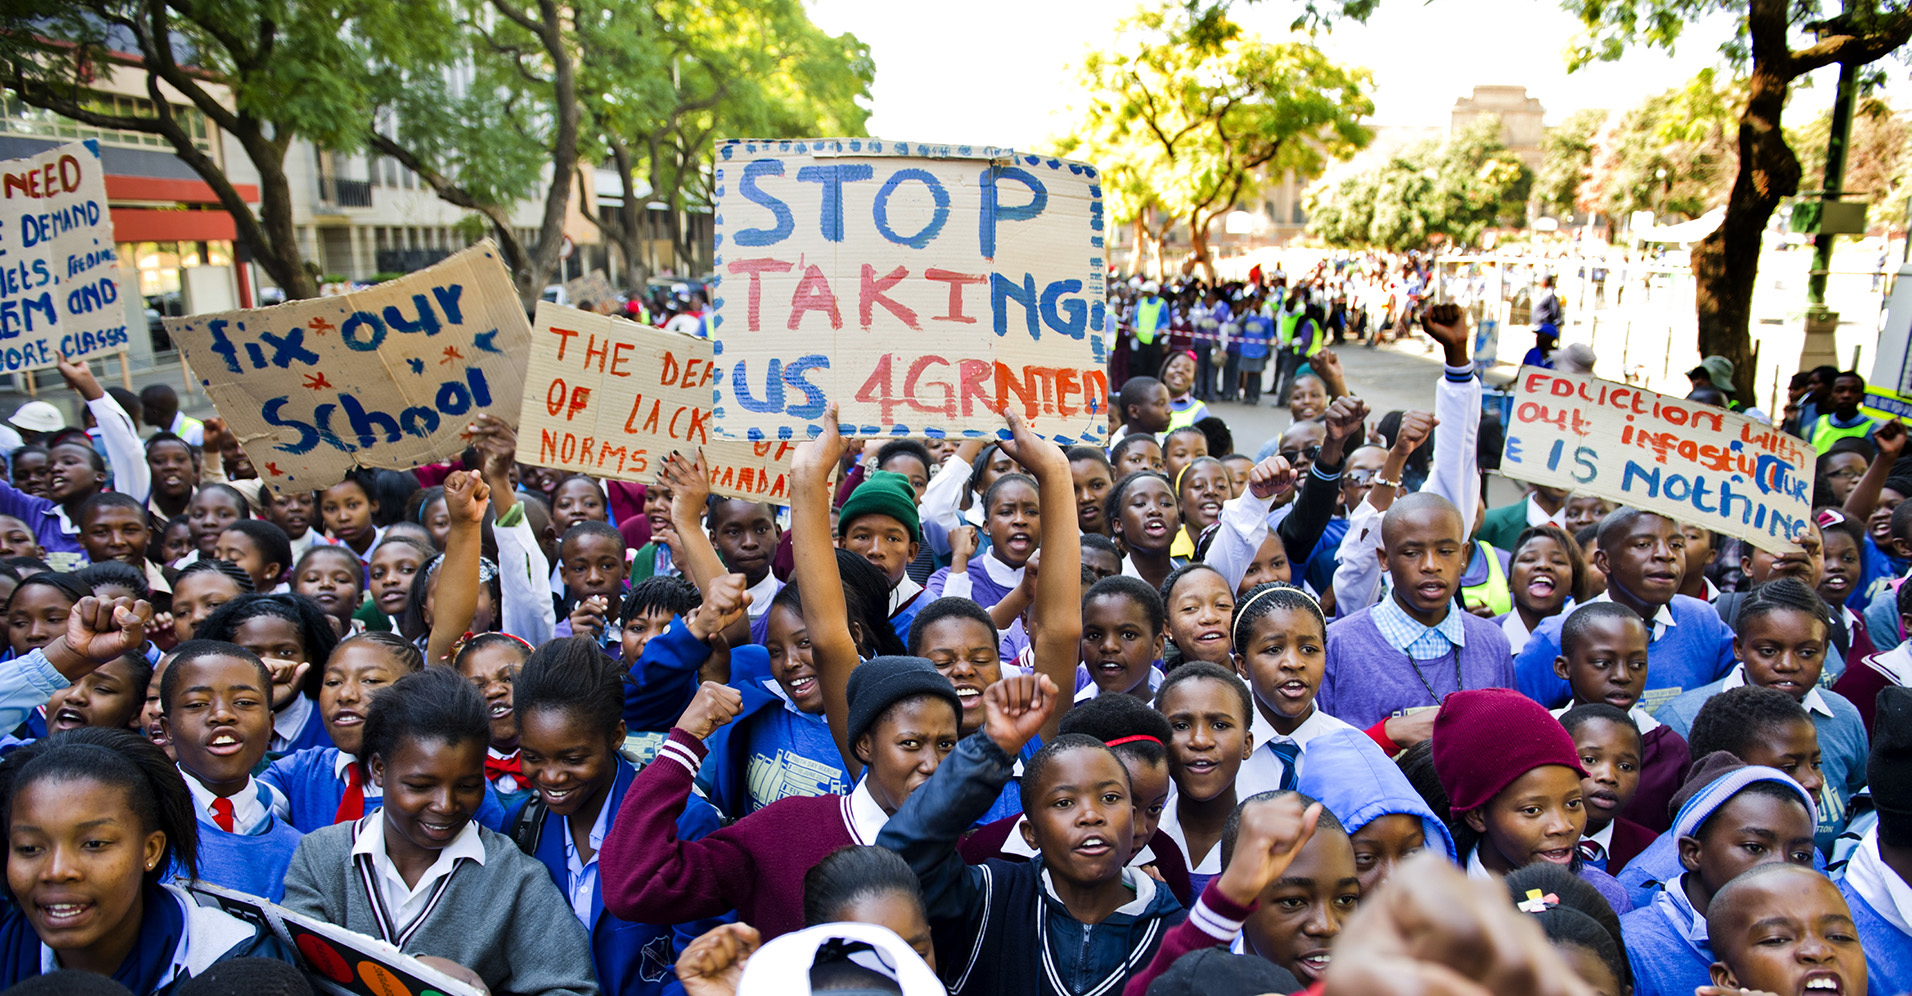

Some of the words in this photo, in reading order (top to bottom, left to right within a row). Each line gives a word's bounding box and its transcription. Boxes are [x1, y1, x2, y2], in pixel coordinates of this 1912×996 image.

[3, 154, 81, 199] NEED
[21, 200, 99, 247] DEMAND
[732, 158, 1048, 260] STOP
[0, 291, 57, 339] EM
[727, 257, 1088, 341] TAKING
[0, 338, 53, 370] ORE
[549, 326, 635, 377] THE
[732, 354, 830, 420] US
[546, 378, 592, 421] OF
[624, 393, 712, 445] LACK
[539, 427, 648, 474] NORMS
[1546, 438, 1600, 484] IS
